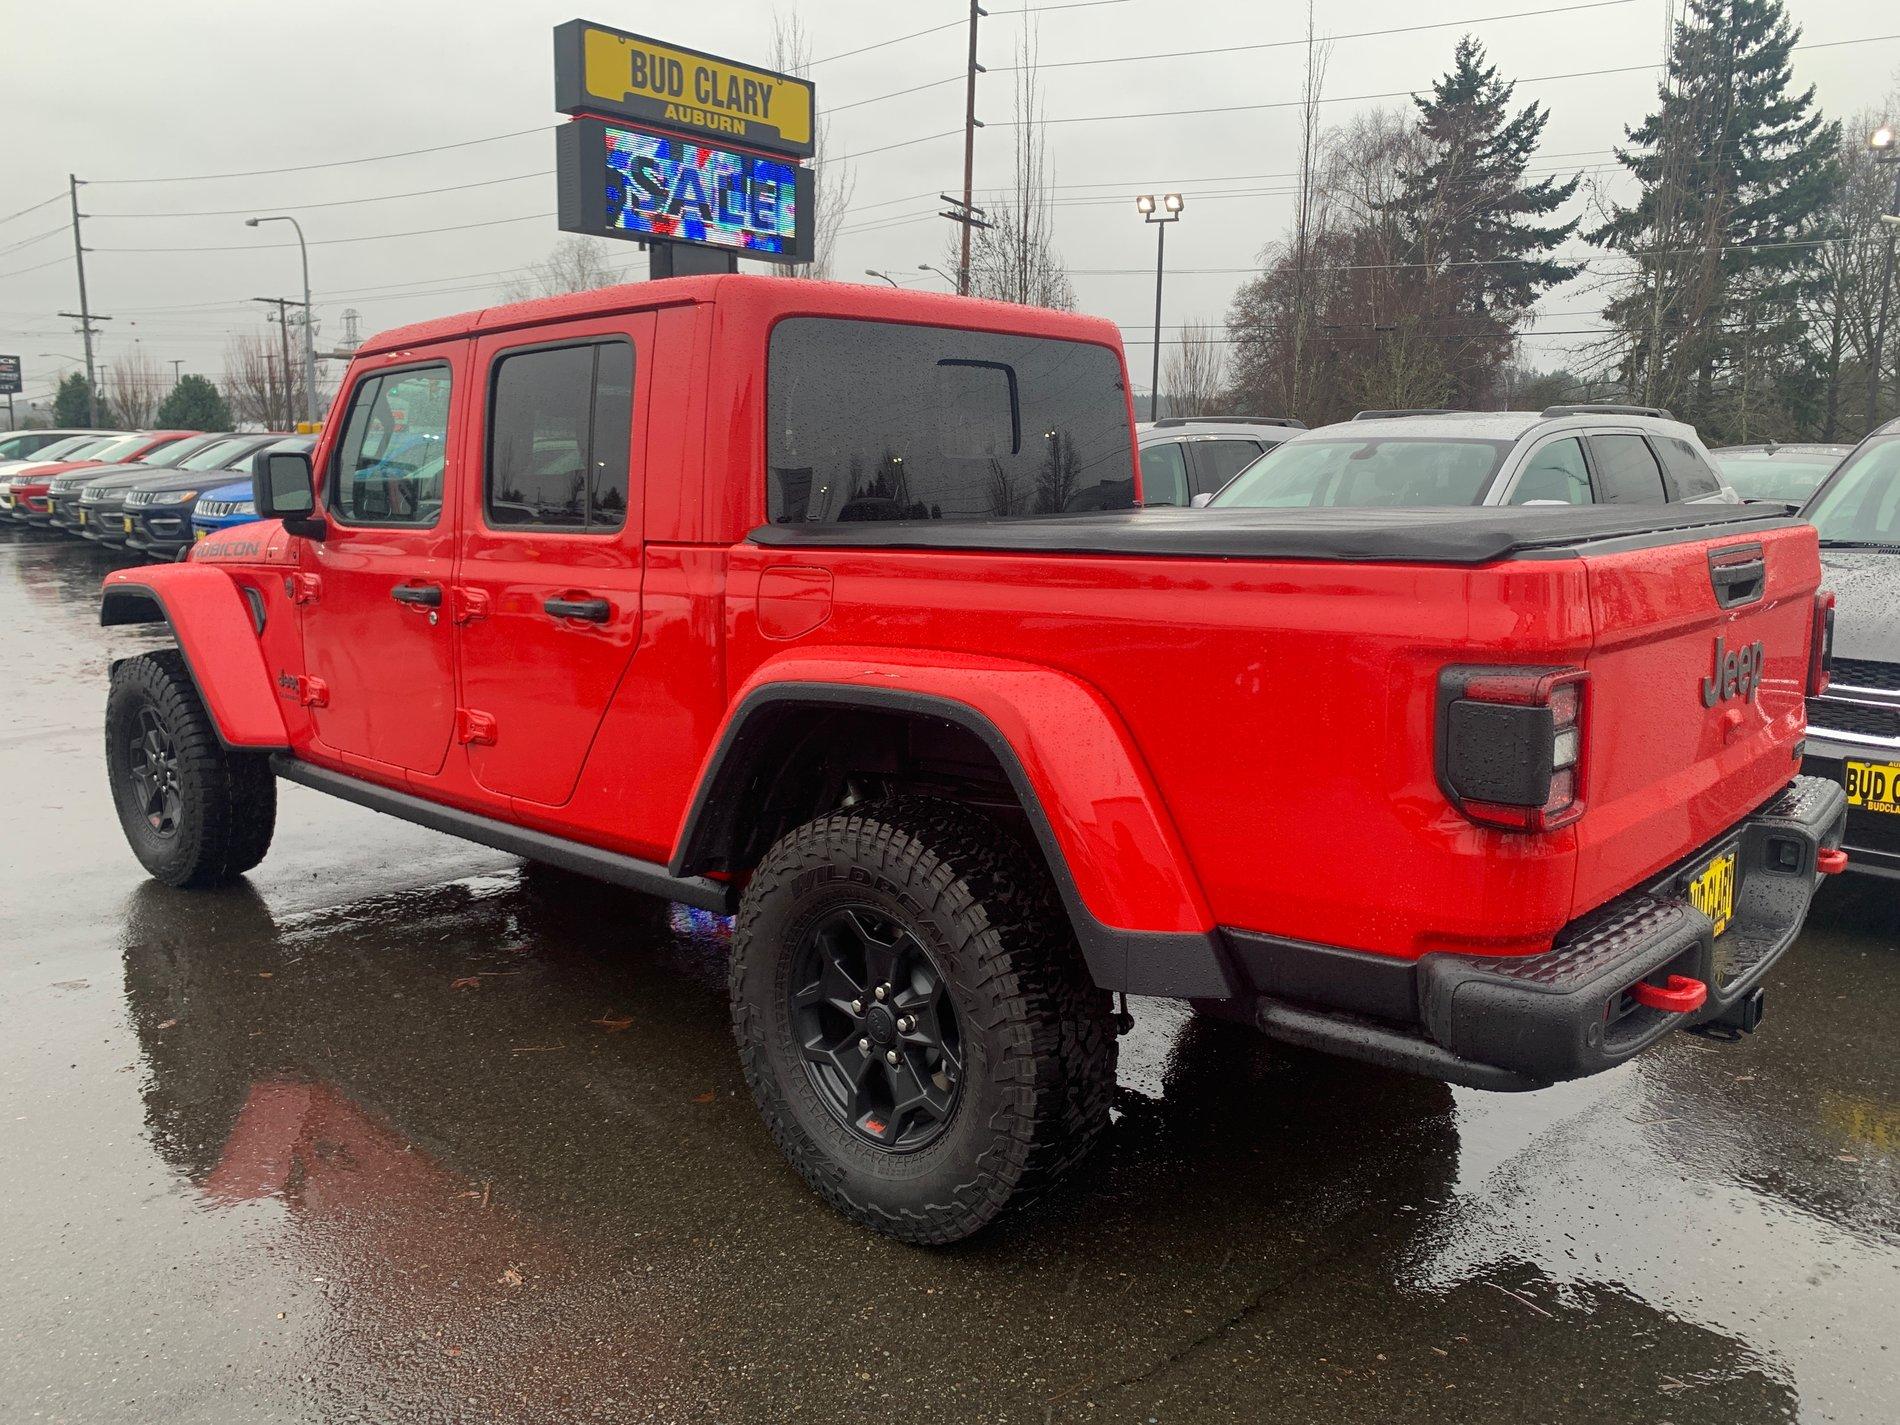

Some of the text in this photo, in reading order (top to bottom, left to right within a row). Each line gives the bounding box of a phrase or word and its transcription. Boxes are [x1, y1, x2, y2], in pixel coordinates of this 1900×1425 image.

[631, 49, 773, 119] BUD CLARY
[664, 104, 746, 136] AUBURN
[626, 155, 778, 231] SALE
[1703, 636, 1764, 708] Jeep
[1846, 768, 1886, 801] BUD
